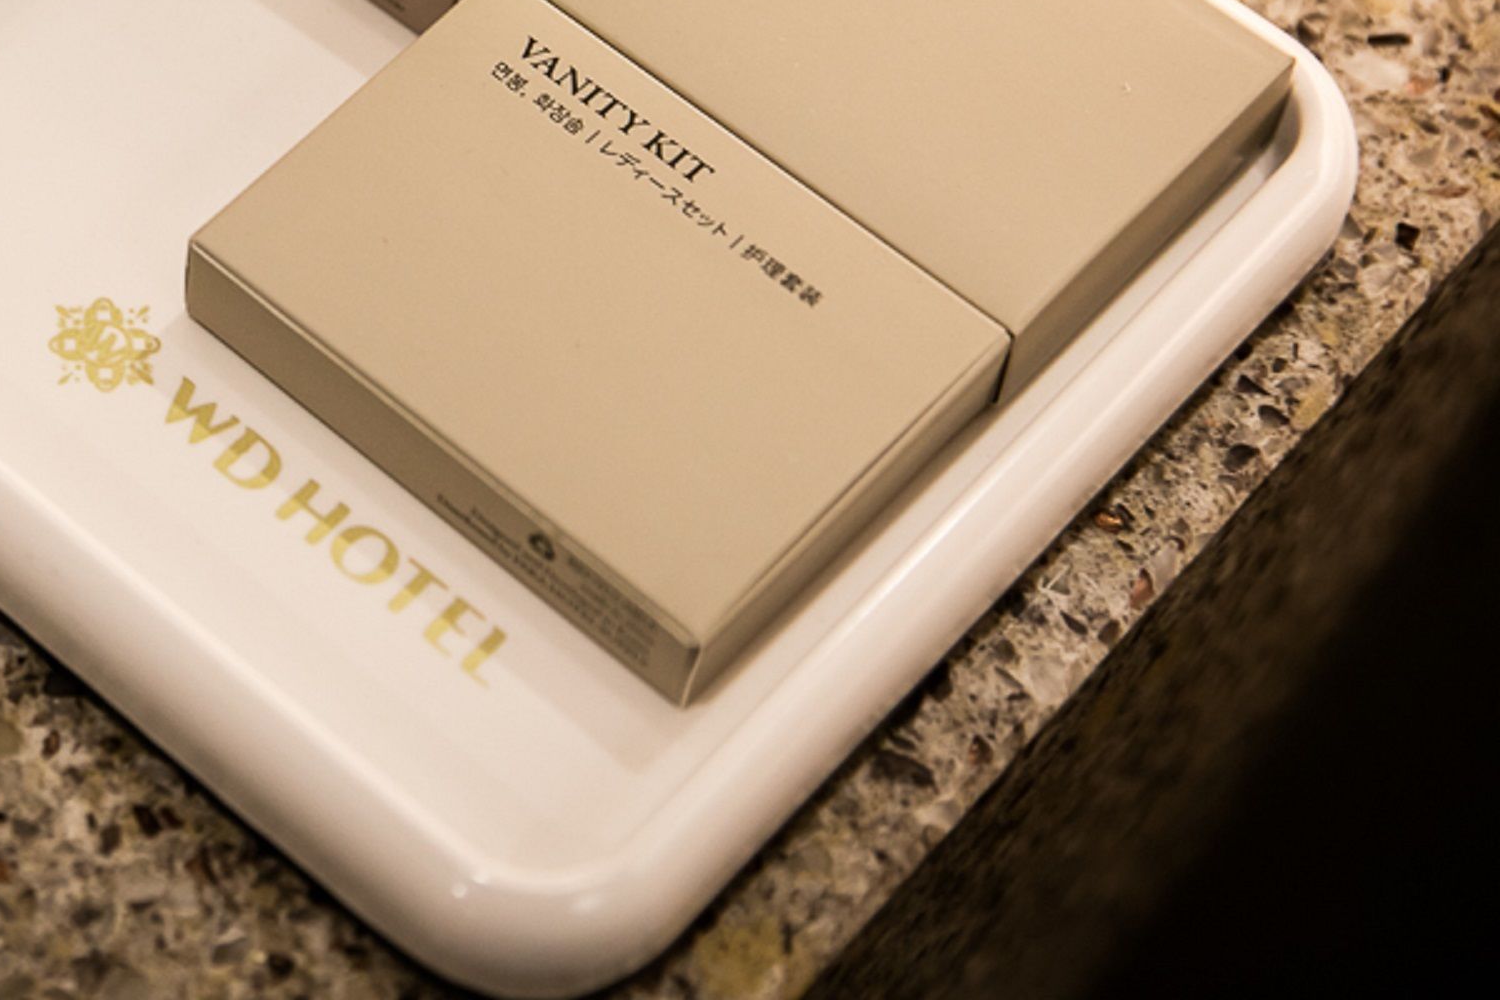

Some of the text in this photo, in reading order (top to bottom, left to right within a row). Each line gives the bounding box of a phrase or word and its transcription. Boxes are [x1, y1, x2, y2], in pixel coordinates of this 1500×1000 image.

[520, 35, 716, 183] VANITY KIT
[599, 140, 729, 237] レディースセット
[165, 376, 283, 491] WD
[274, 478, 508, 689] HOTEL
